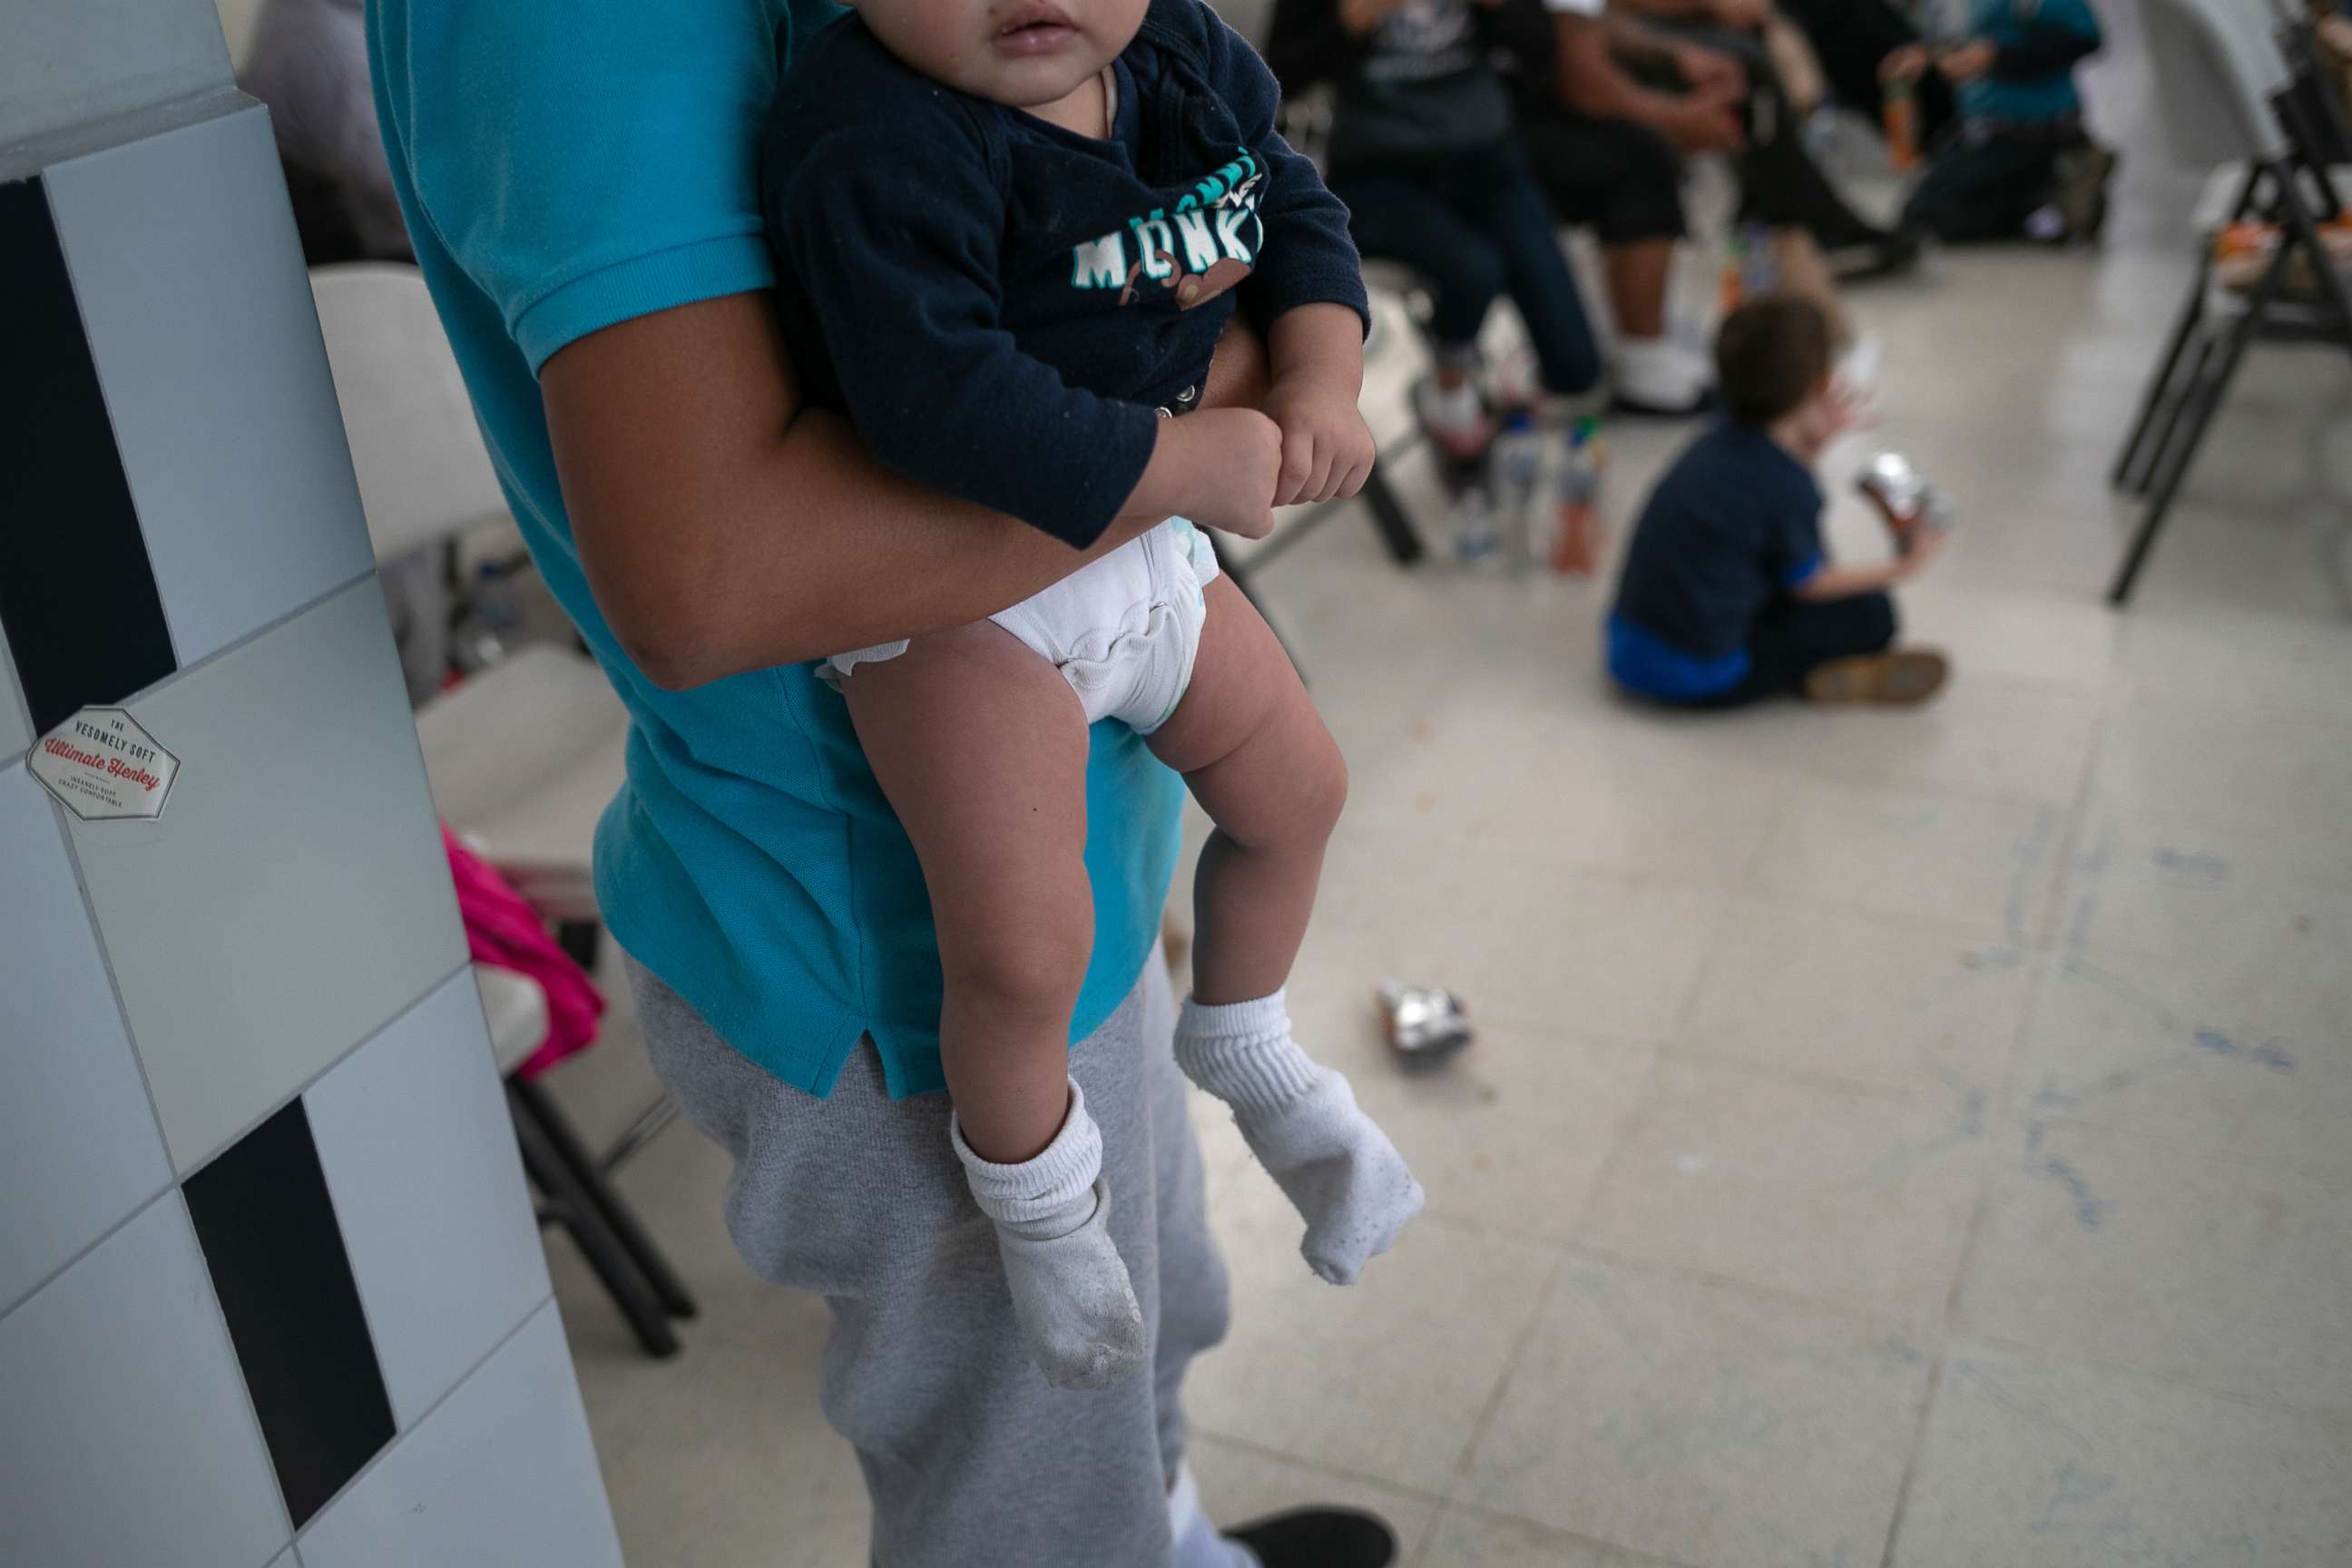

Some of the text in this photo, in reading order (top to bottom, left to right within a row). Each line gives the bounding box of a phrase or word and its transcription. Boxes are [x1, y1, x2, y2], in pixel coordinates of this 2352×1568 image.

[111, 719, 124, 731] THE
[130, 743, 156, 763] SOFT
[44, 737, 160, 791] Ultimate Henley
[58, 779, 78, 791] CRAZY
[70, 776, 100, 792] INSANELY
